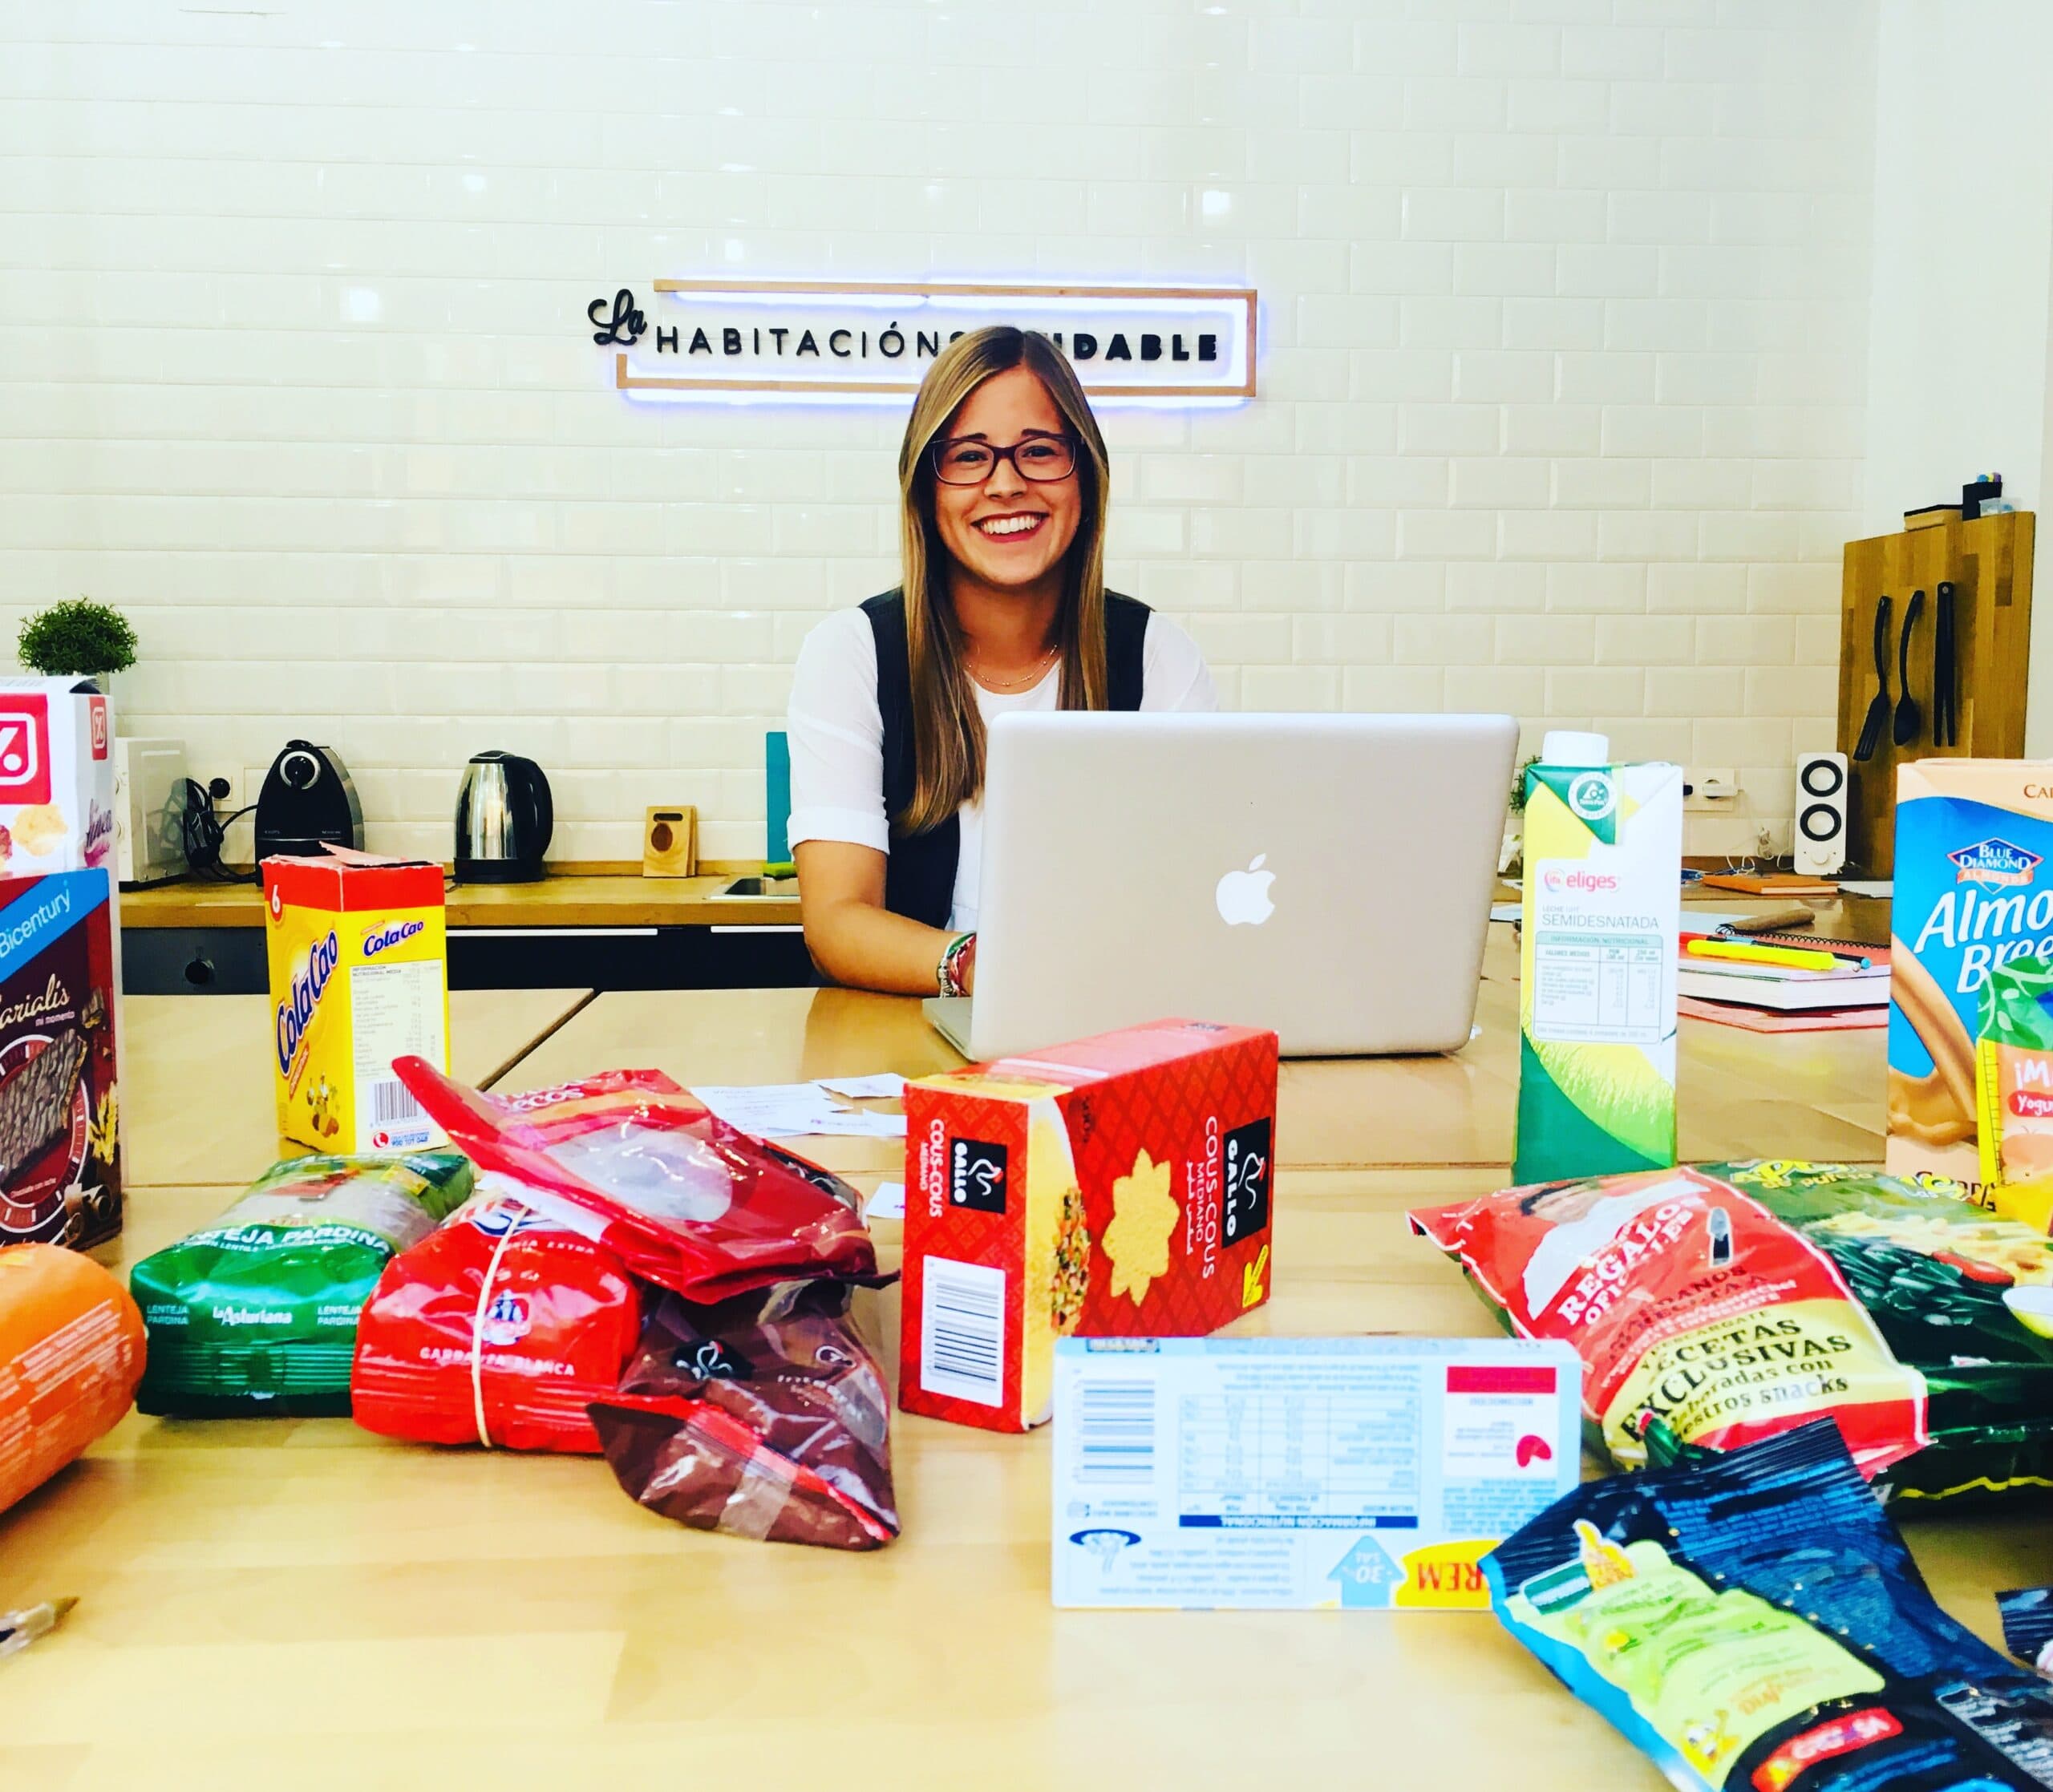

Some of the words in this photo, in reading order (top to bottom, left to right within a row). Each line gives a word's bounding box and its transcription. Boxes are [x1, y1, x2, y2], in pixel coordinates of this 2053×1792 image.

[588, 288, 647, 346] La
[655, 322, 939, 358] HABITACIÓN
[1959, 855, 2031, 870] DIAMOND
[1978, 843, 2013, 860] BLUE
[1566, 871, 1618, 892] eliges
[271, 884, 281, 914] 6
[1541, 912, 1660, 929] SEMIDESNATADA
[929, 1118, 946, 1218] COUS-COUS
[954, 1142, 968, 1203] GALLO
[1195, 1162, 1205, 1243] MEDIANO
[1202, 1115, 1218, 1280] COUS-COUS
[1227, 1139, 1238, 1238] GALLO
[281, 1226, 391, 1254] PARDINA
[146, 1305, 189, 1315] LENTEJA
[146, 1315, 189, 1325] PARDINA
[1785, 1359, 1834, 1375] con
[1416, 1562, 1483, 1592] REM
